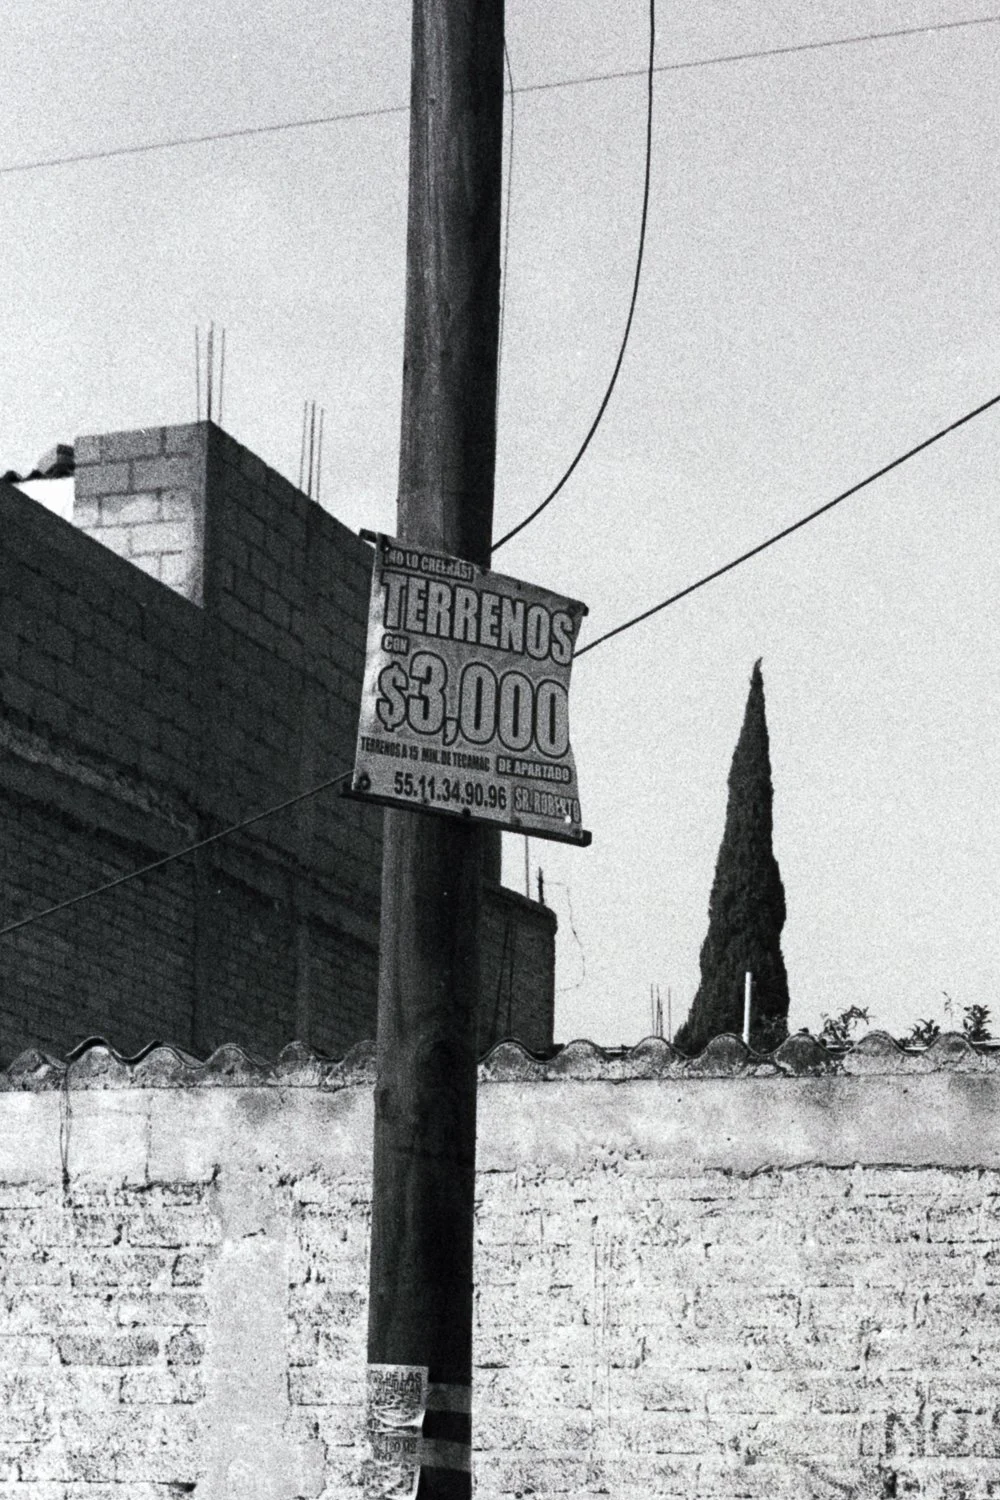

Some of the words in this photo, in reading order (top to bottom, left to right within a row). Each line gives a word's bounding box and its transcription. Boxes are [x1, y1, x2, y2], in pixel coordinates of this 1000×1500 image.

[406, 553, 419, 568] LO
[380, 570, 575, 667] TERRENOS
[382, 634, 409, 655] CON
[376, 650, 569, 759] $3,000
[361, 737, 401, 758] TERRENOS
[401, 744, 408, 758] A
[409, 746, 419, 760] 15
[441, 750, 451, 766] DE
[498, 758, 513, 775] DE
[514, 760, 571, 783] APARTADO
[394, 771, 507, 810] 55.11.34.90.96
[514, 786, 533, 812] SR.
[532, 790, 581, 824] ROBERTO
